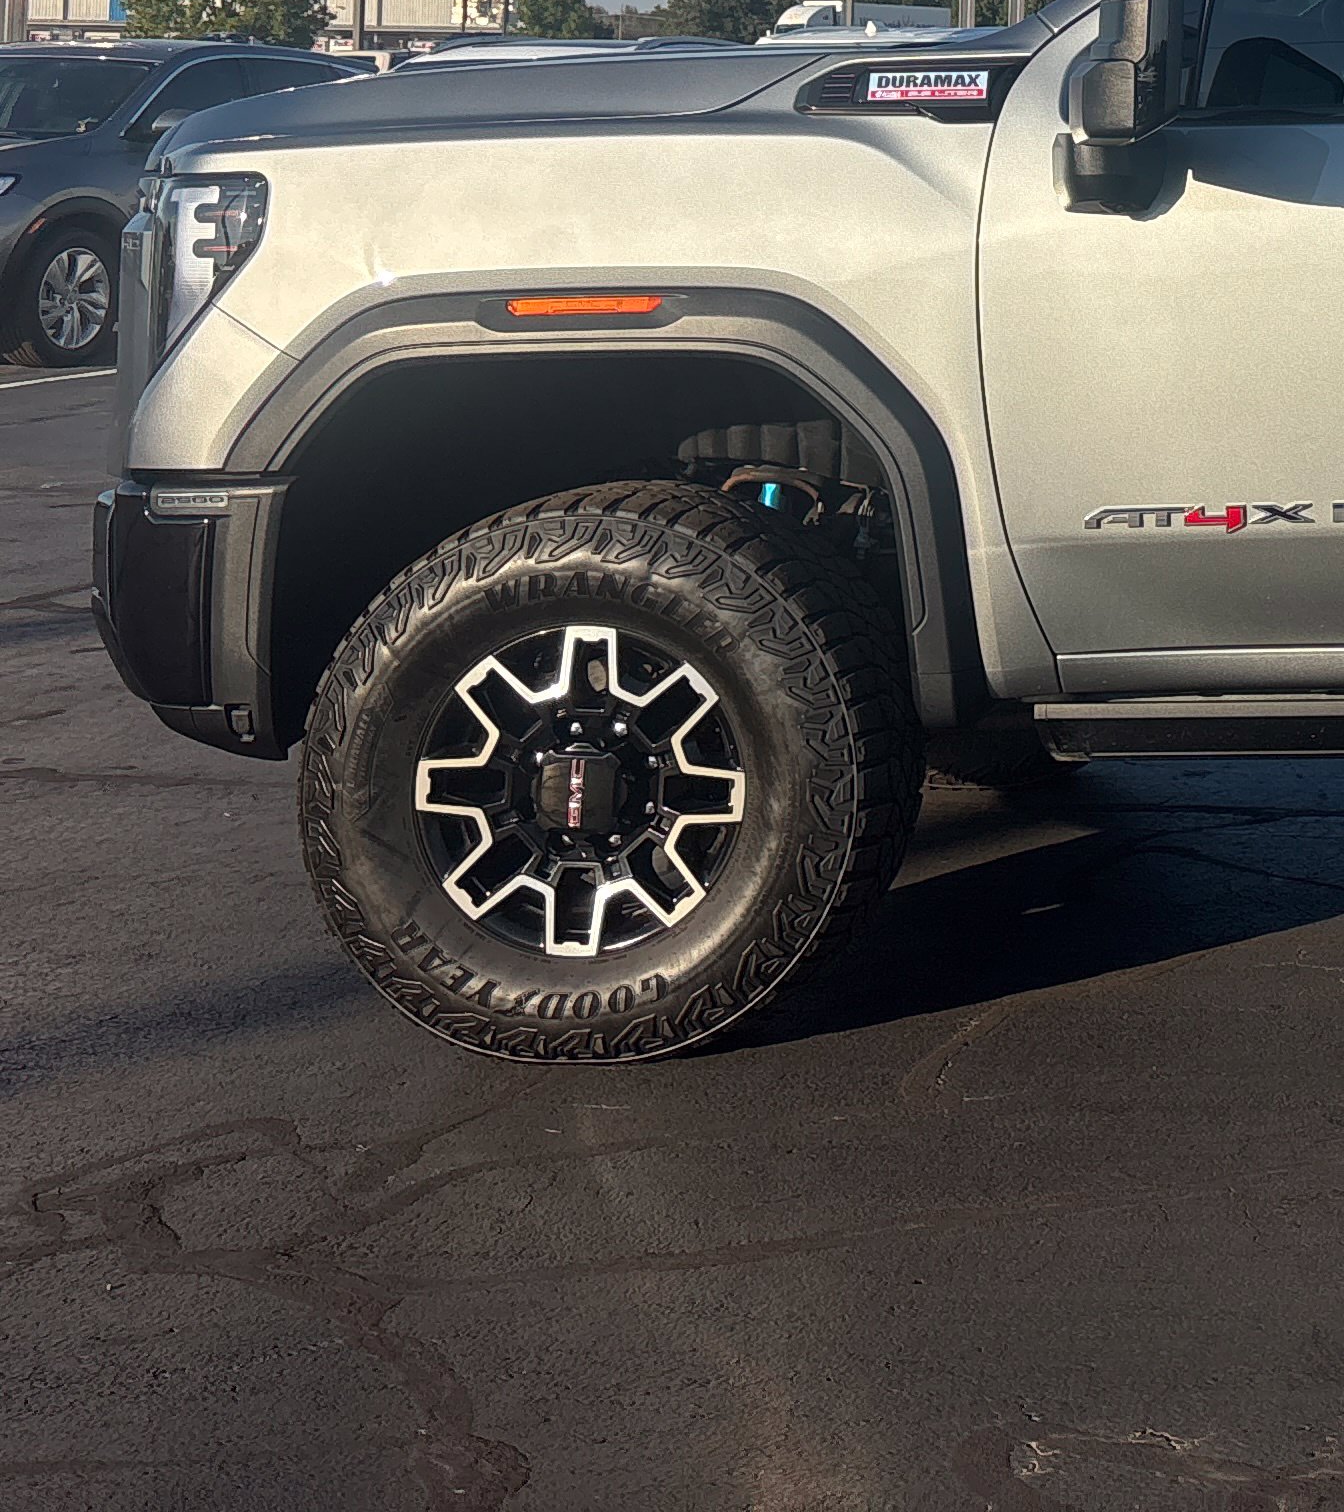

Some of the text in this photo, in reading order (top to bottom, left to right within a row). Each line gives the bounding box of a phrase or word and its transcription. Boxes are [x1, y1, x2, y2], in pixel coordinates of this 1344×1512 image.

[877, 74, 981, 88] DURAMAX
[1084, 501, 1316, 534] AT4X
[481, 570, 741, 655] WRANGLER
[567, 758, 586, 827] GMC
[389, 920, 672, 1021] GOODYEAR
